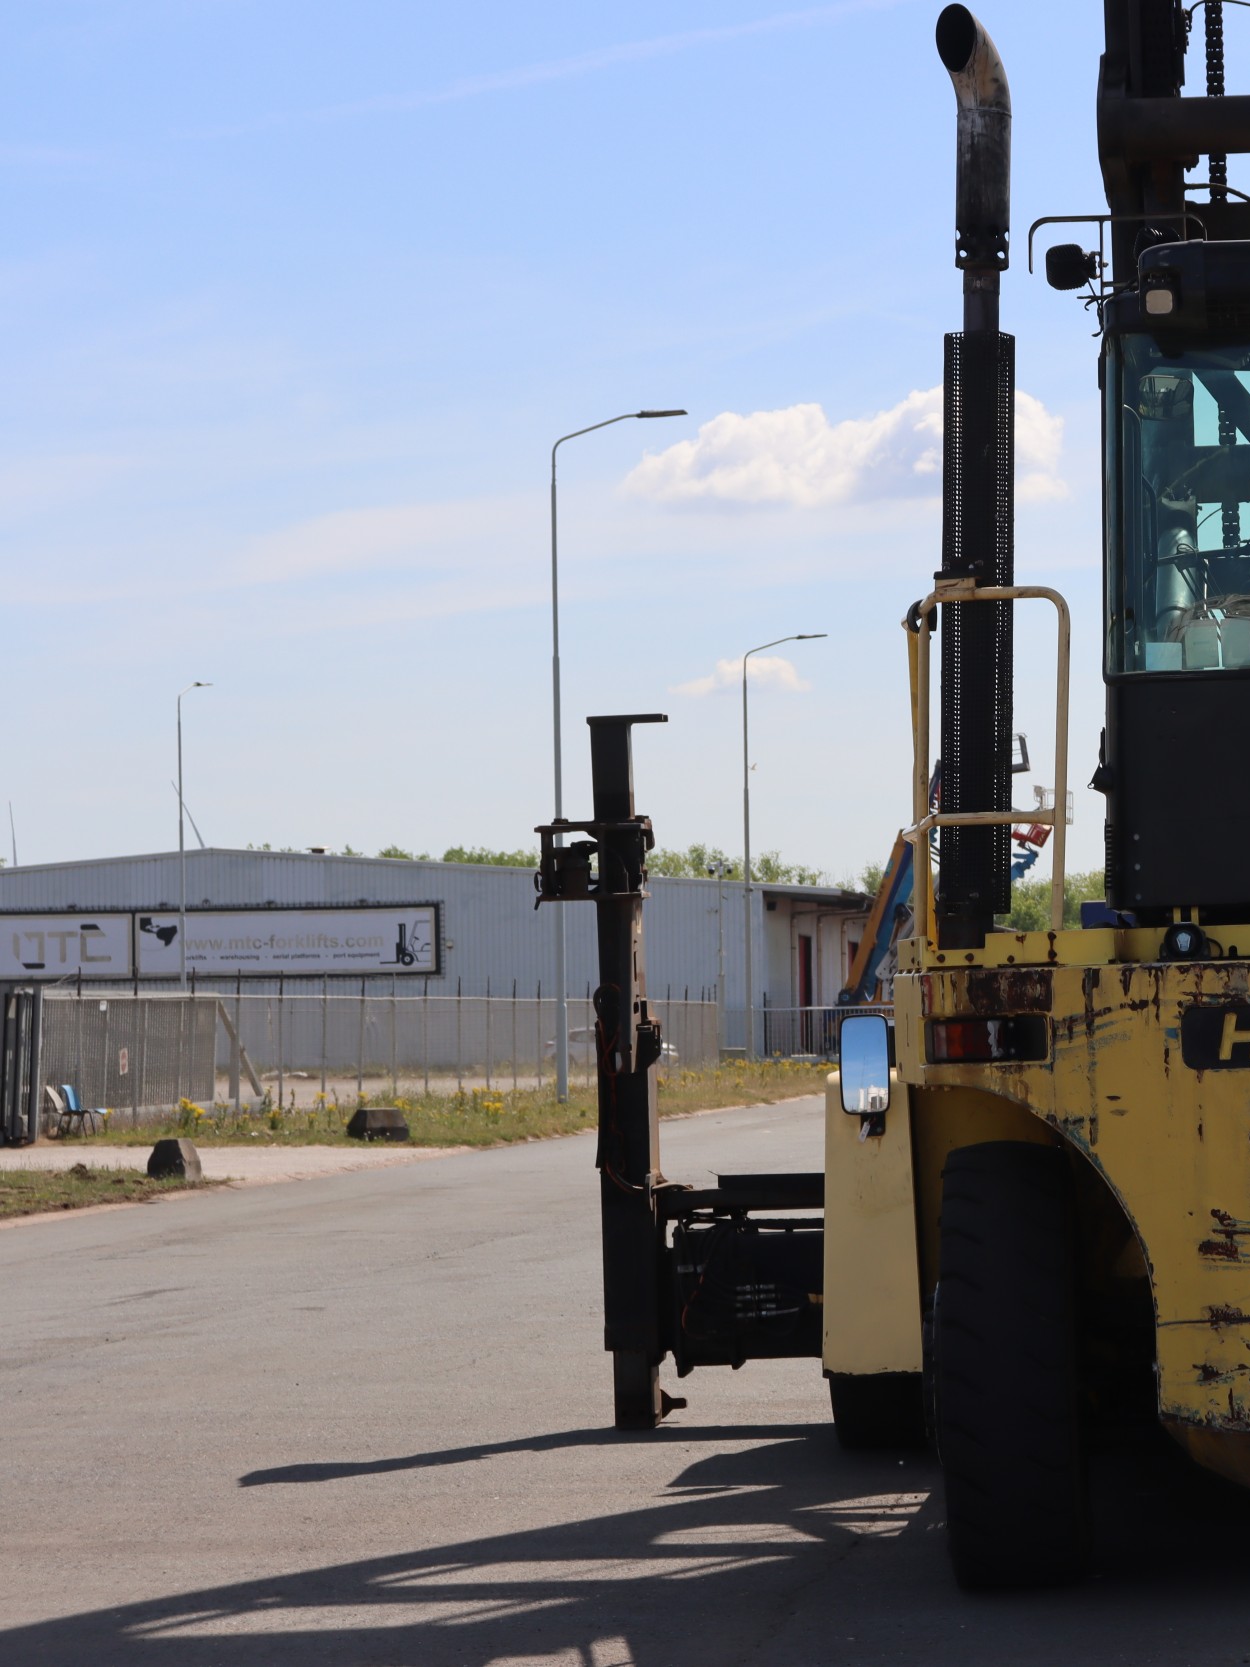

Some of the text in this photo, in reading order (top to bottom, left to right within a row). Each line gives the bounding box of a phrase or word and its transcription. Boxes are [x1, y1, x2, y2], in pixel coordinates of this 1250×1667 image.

[220, 953, 260, 961] warehousing
[290, 953, 321, 961] platforms
[347, 952, 380, 960] equipment
